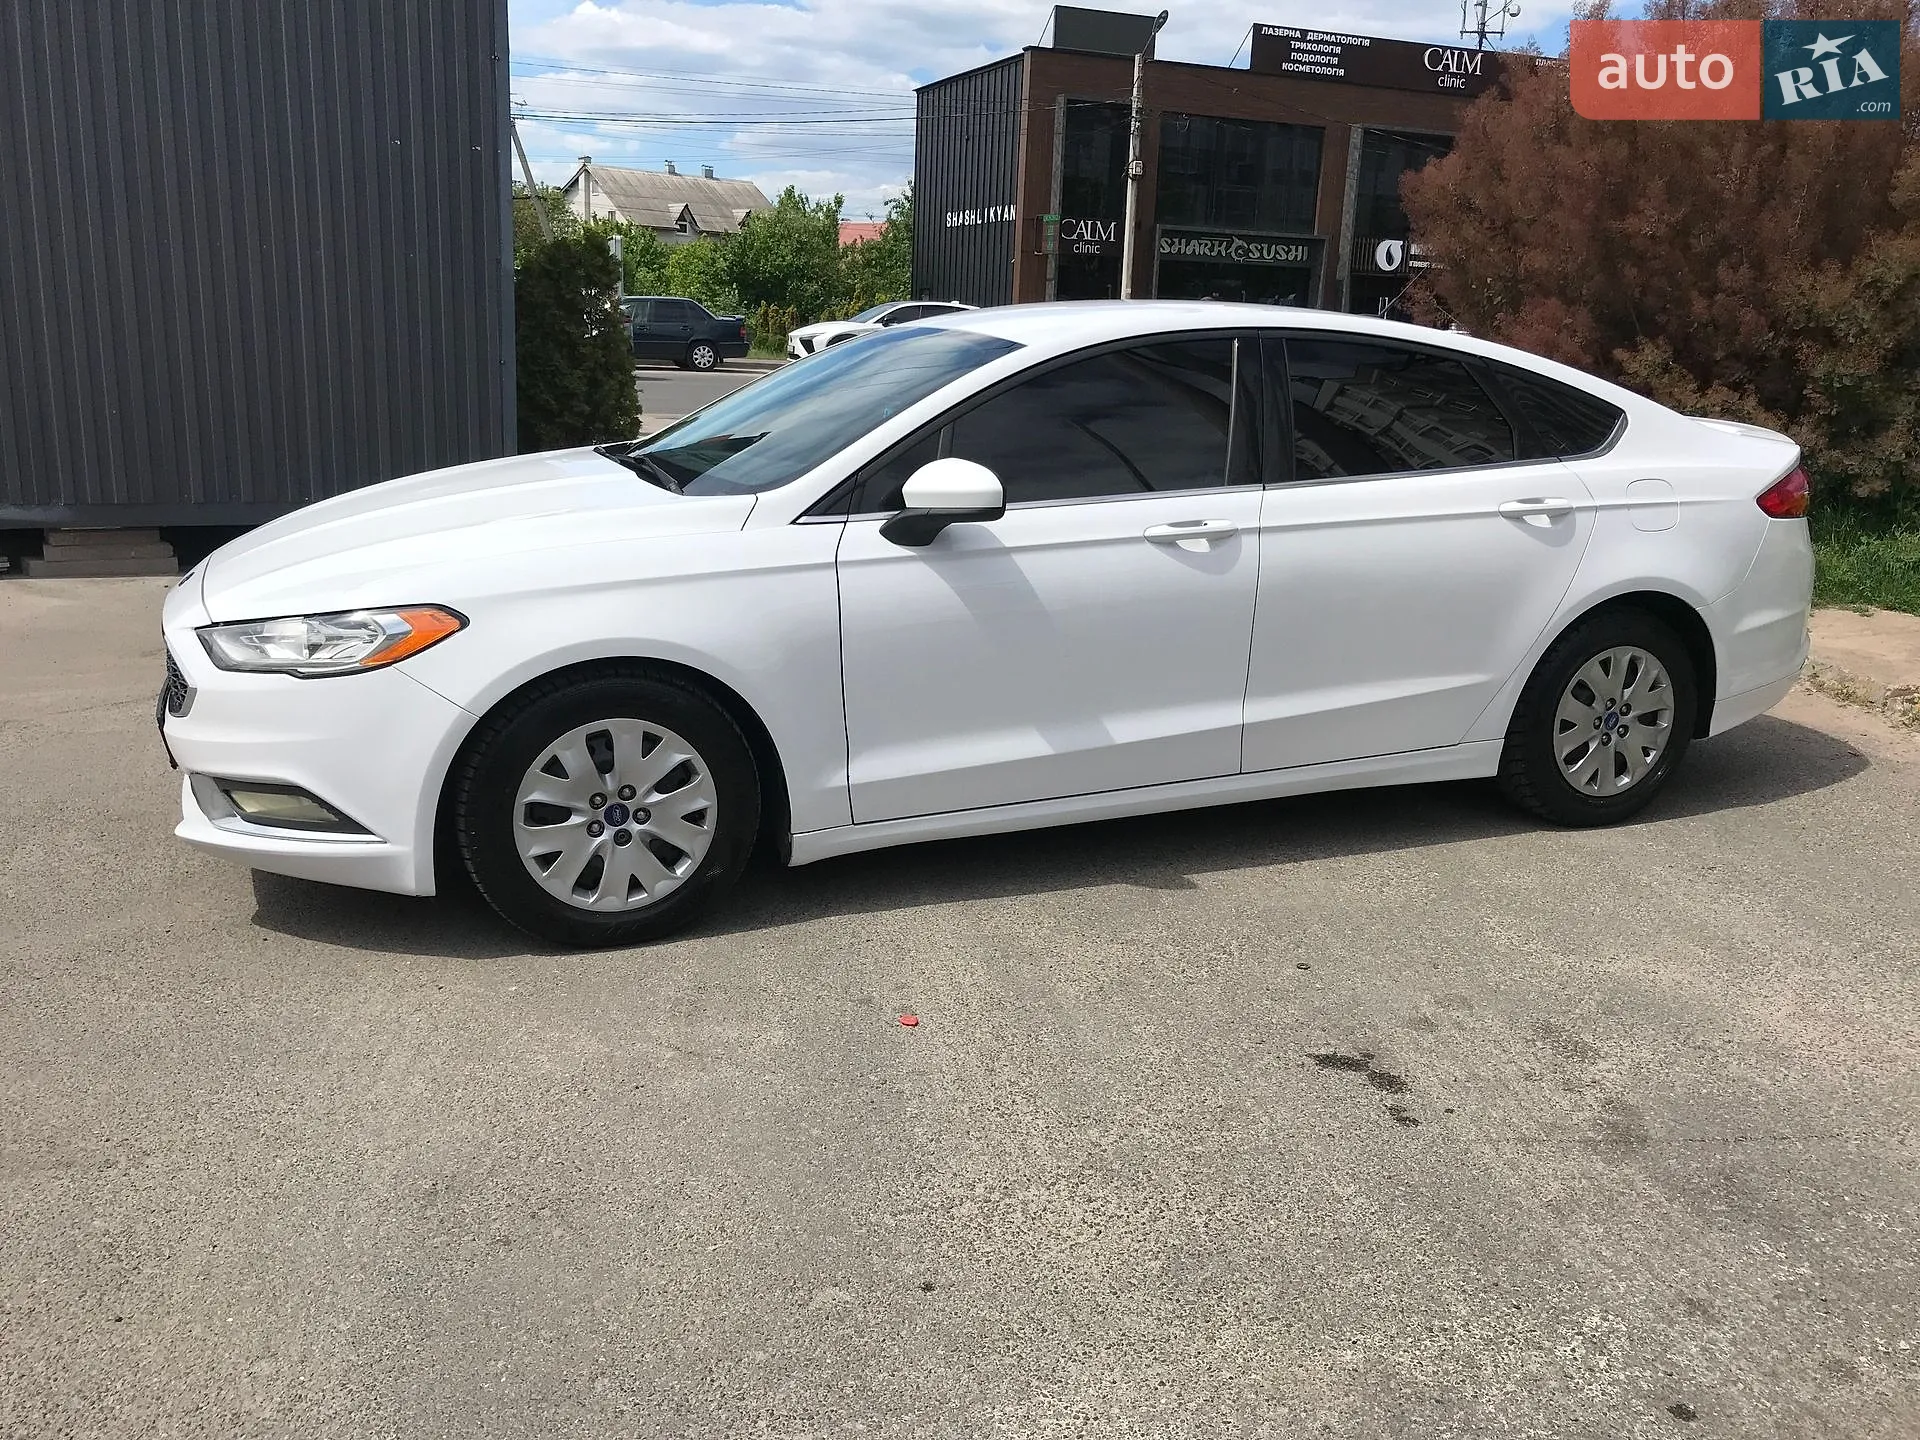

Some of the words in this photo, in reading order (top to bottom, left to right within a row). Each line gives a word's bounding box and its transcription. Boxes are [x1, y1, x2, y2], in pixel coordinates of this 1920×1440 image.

[1261, 26, 1301, 38] ЛАЗЕРНА
[1306, 31, 1371, 47] ДЕРМАТОЛОГІЯ
[1290, 40, 1341, 54] ТРИХОЛОГІЯ
[1290, 52, 1339, 65] ПОДОЛОГІЯ
[1423, 47, 1484, 76] CALM
[1281, 62, 1345, 77] КОСМЕТОЛОГІЯ
[1437, 74, 1466, 89] clinic
[946, 204, 1016, 228] SHASHLIKYAN
[1061, 218, 1118, 242] CALM
[1073, 241, 1101, 254] clinic
[1159, 237, 1227, 257] SHARK
[1248, 243, 1309, 262] SUSHI
